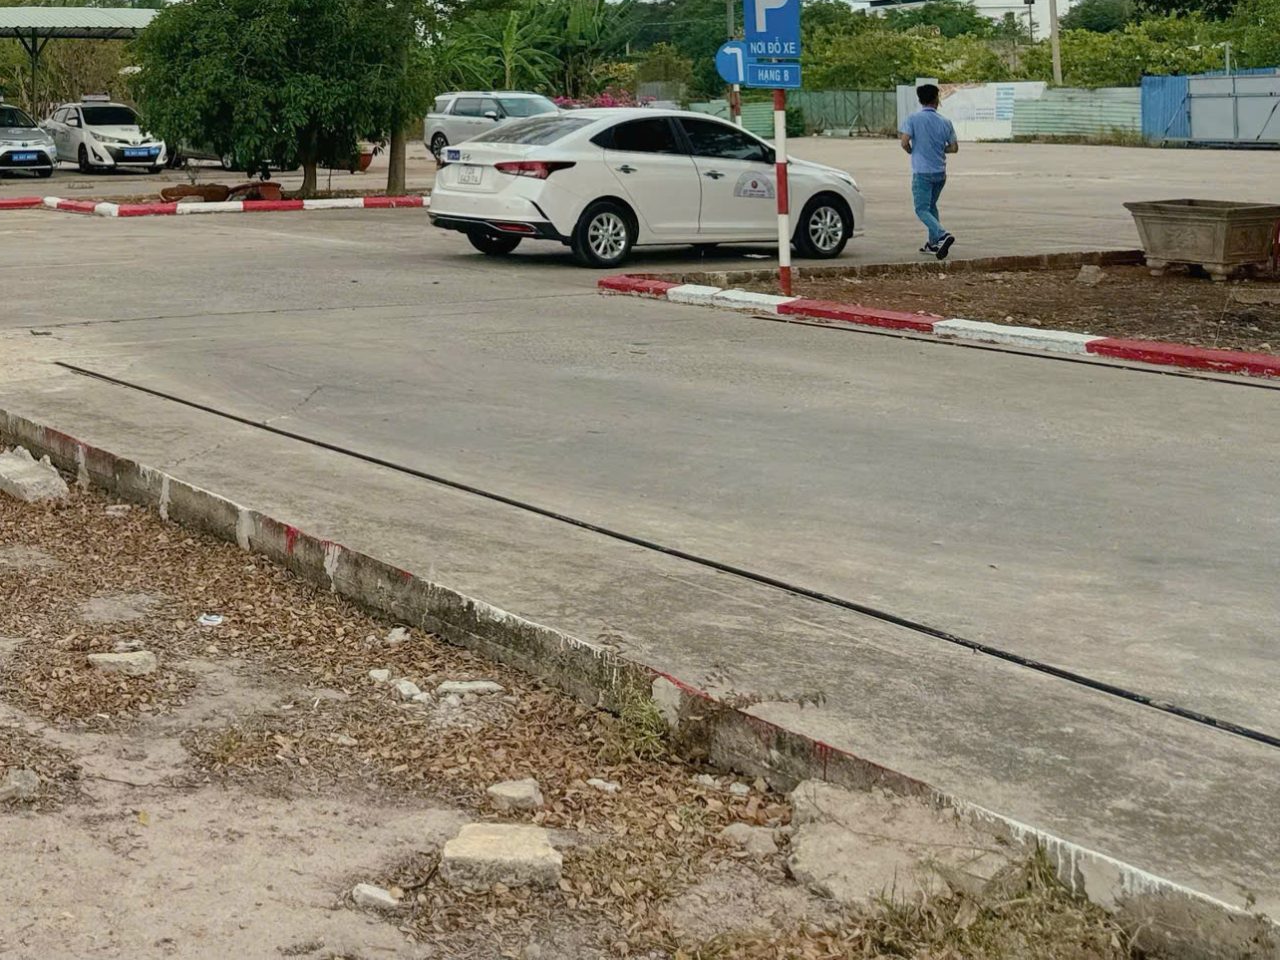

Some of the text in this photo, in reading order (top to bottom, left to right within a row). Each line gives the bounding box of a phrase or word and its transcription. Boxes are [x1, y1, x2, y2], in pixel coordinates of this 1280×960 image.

[750, 36, 796, 54] NƠI ĐỖ XE
[758, 70, 780, 83] HẠNG
